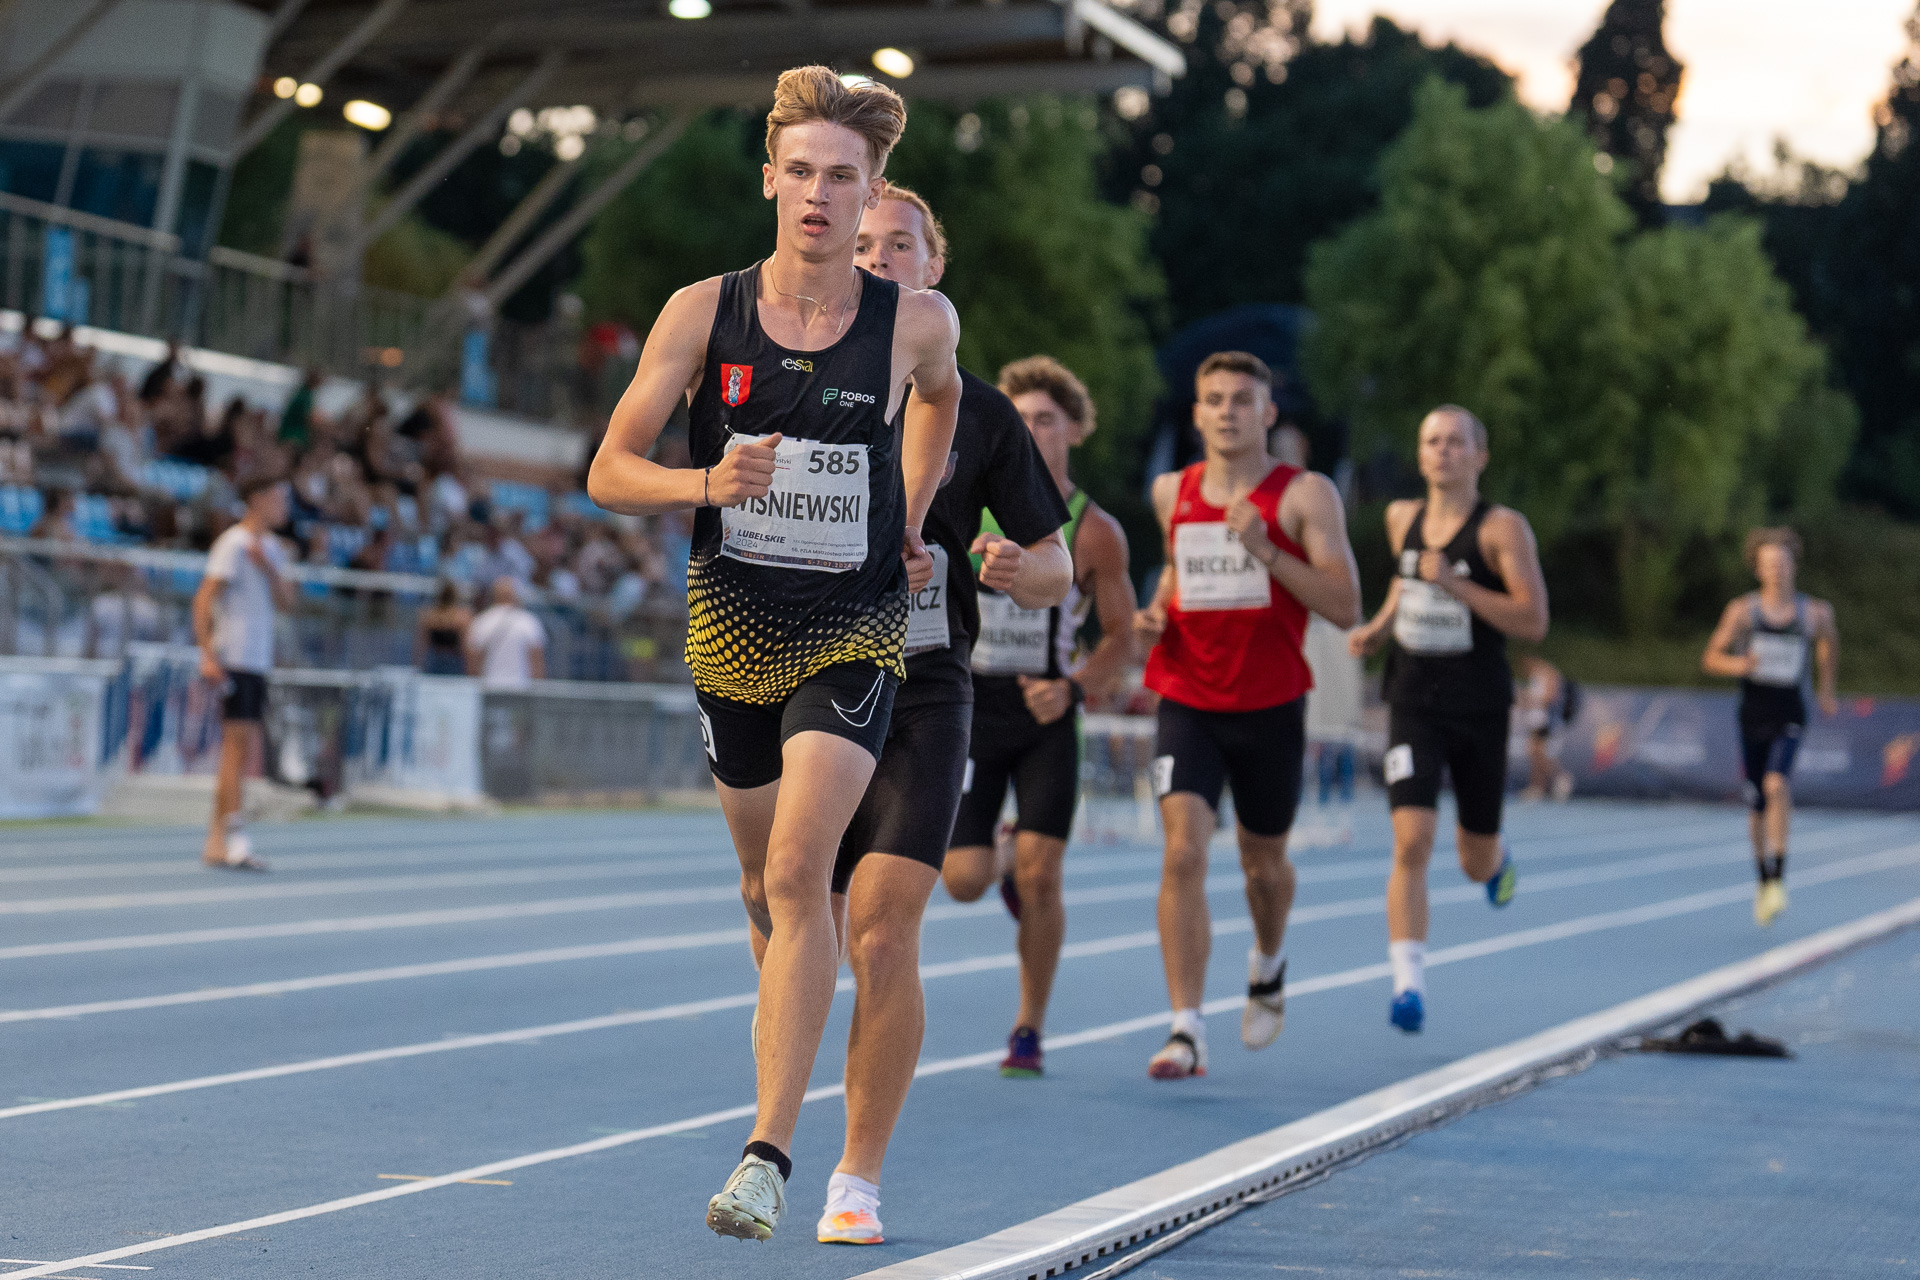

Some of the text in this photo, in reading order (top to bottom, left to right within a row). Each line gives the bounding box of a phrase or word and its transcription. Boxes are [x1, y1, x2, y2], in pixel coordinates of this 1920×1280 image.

[839, 400, 855, 408] ONE
[840, 391, 876, 404] FOBOS
[807, 449, 860, 475] 585
[735, 537, 758, 549] 2024
[737, 528, 787, 544] LUBELSKIE
[908, 585, 942, 612] ICZ
